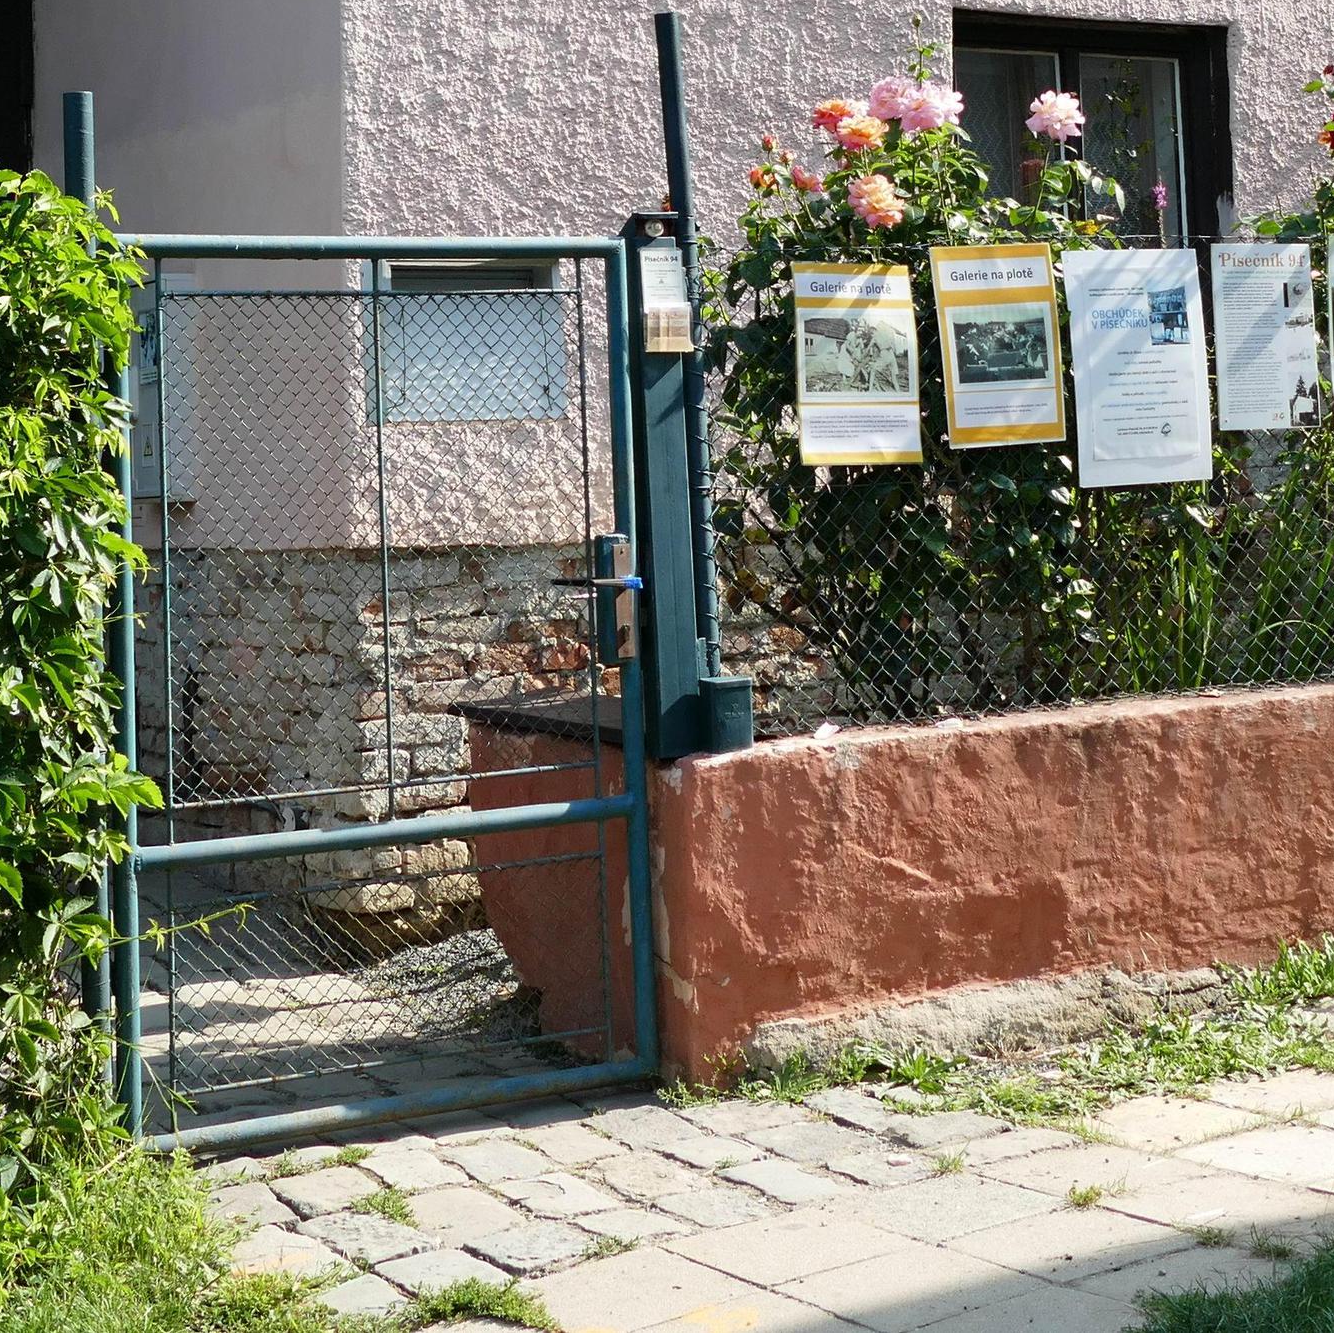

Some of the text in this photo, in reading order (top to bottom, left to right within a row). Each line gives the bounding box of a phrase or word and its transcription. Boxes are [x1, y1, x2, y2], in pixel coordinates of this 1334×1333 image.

[670, 255, 678, 263] 94
[1220, 252, 1305, 268] Písečník 94
[950, 267, 1033, 282] Galerie na plotě
[810, 281, 892, 296] Galerie na plotě
[1092, 307, 1145, 320] OBCHŮDEK
[1092, 320, 1098, 329] V
